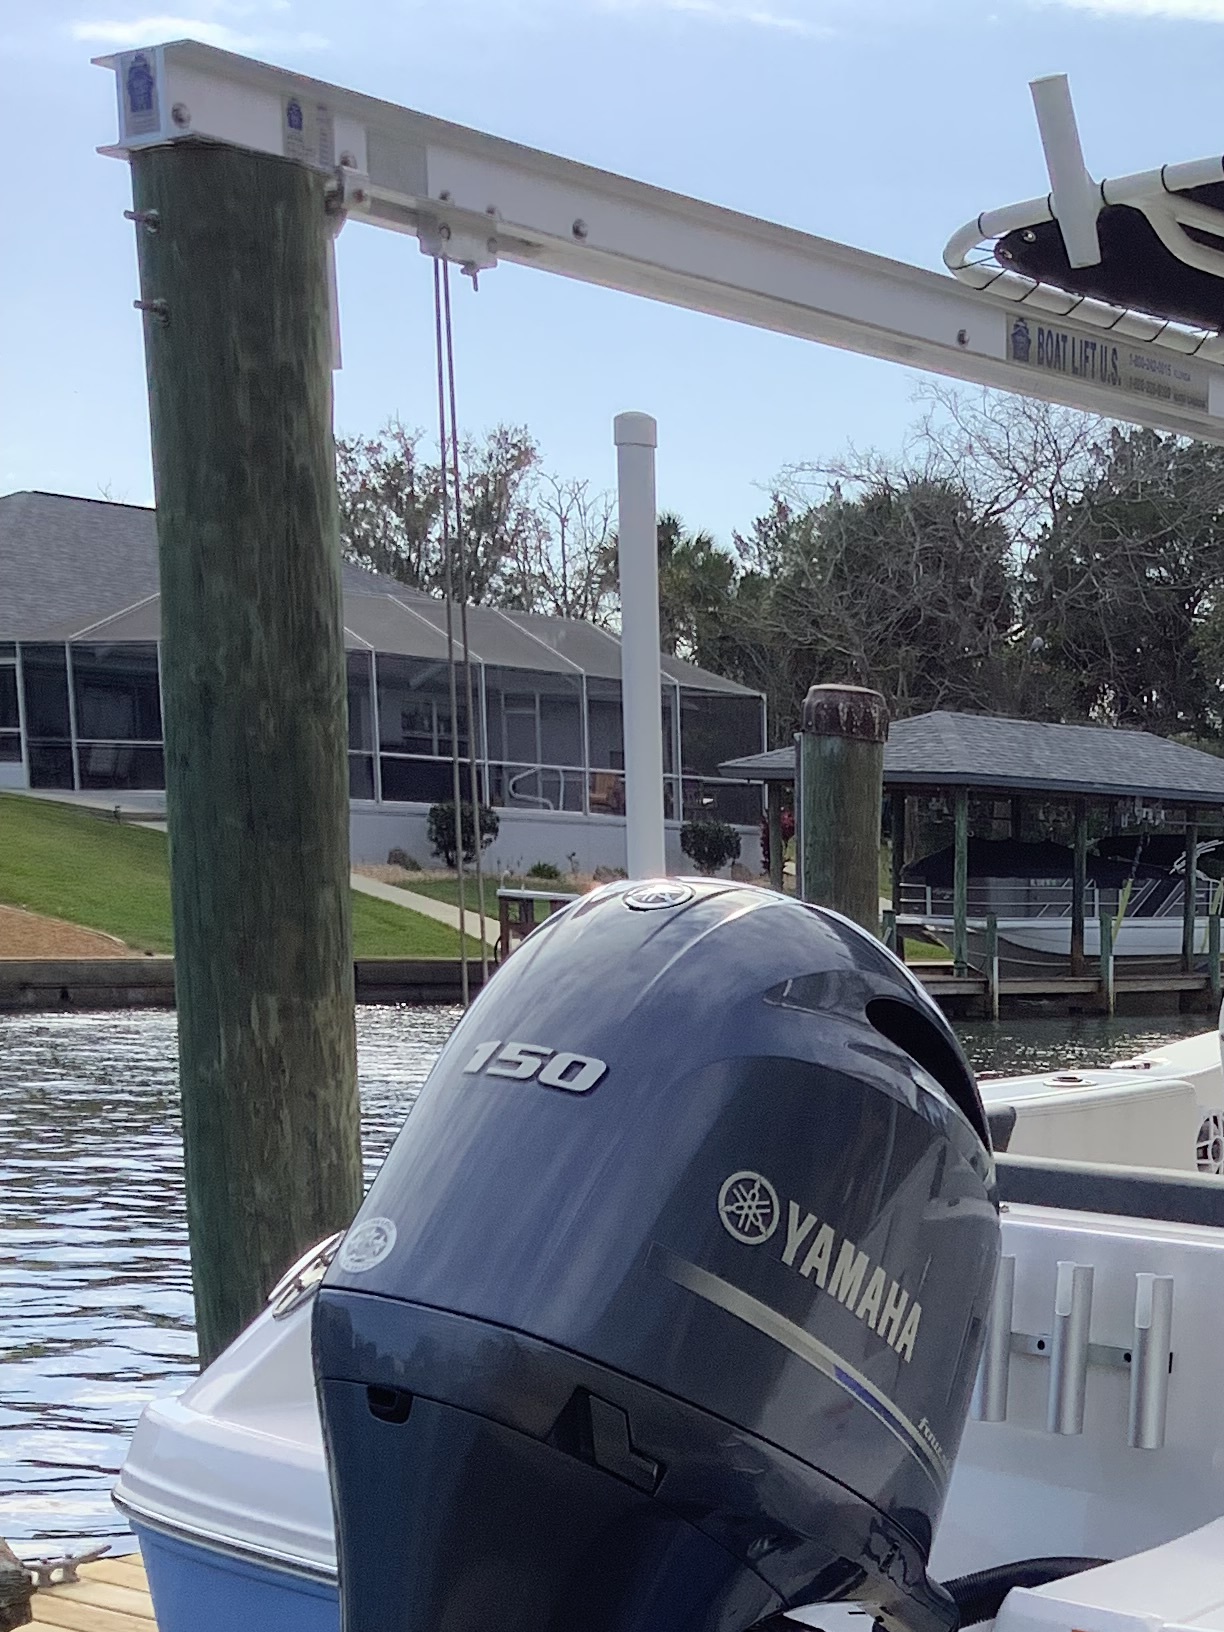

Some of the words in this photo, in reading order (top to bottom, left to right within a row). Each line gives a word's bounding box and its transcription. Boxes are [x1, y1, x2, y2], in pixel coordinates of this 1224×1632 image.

[1037, 327, 1067, 372] BOAT
[1071, 336, 1096, 379] LIFT
[462, 1040, 607, 1094] 150
[780, 1200, 922, 1363] YAMAHA
